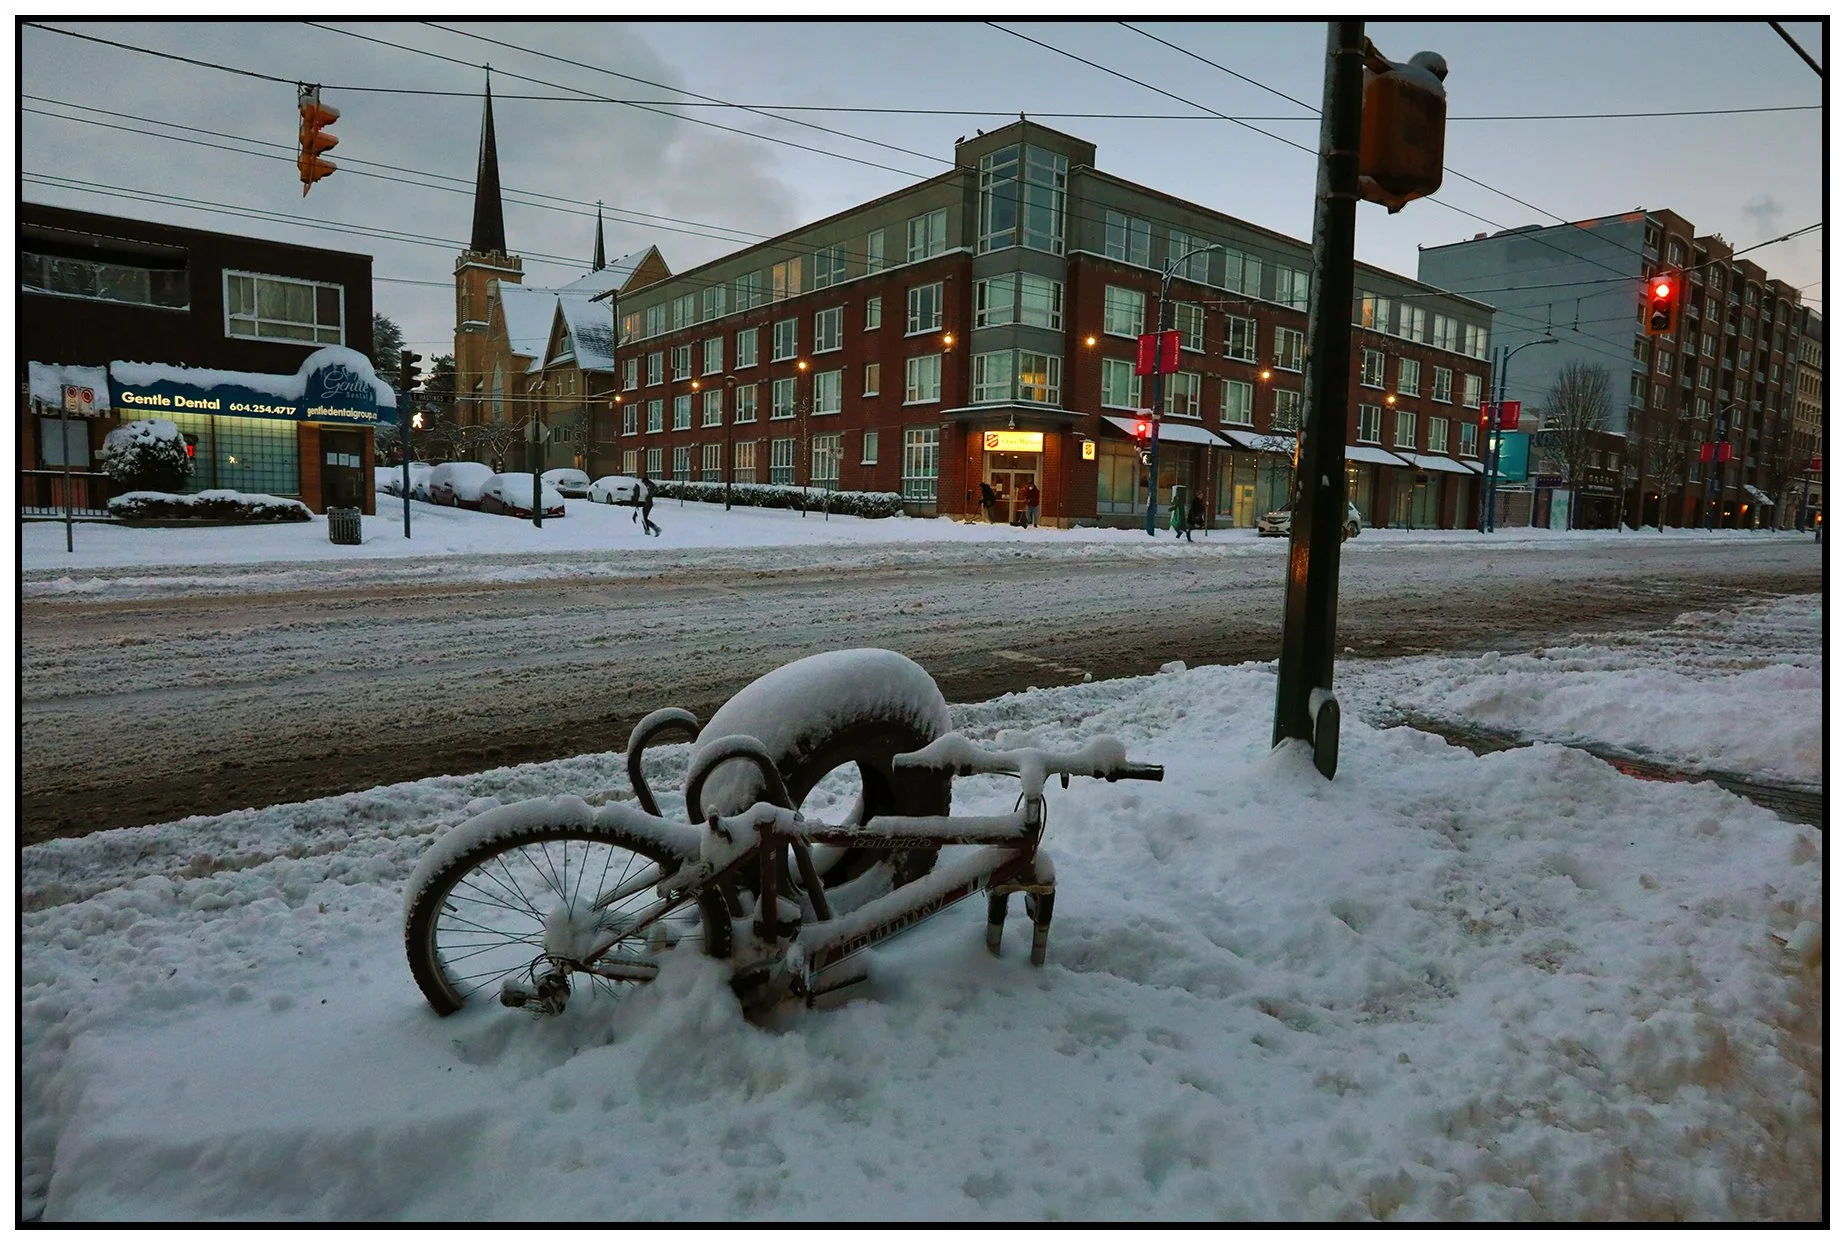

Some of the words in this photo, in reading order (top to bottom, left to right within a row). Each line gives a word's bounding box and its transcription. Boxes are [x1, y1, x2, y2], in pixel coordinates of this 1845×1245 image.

[322, 371, 369, 398] Gentle
[121, 391, 171, 407] Gentle
[174, 395, 221, 410] Dental
[229, 402, 297, 416] 604.254.4717
